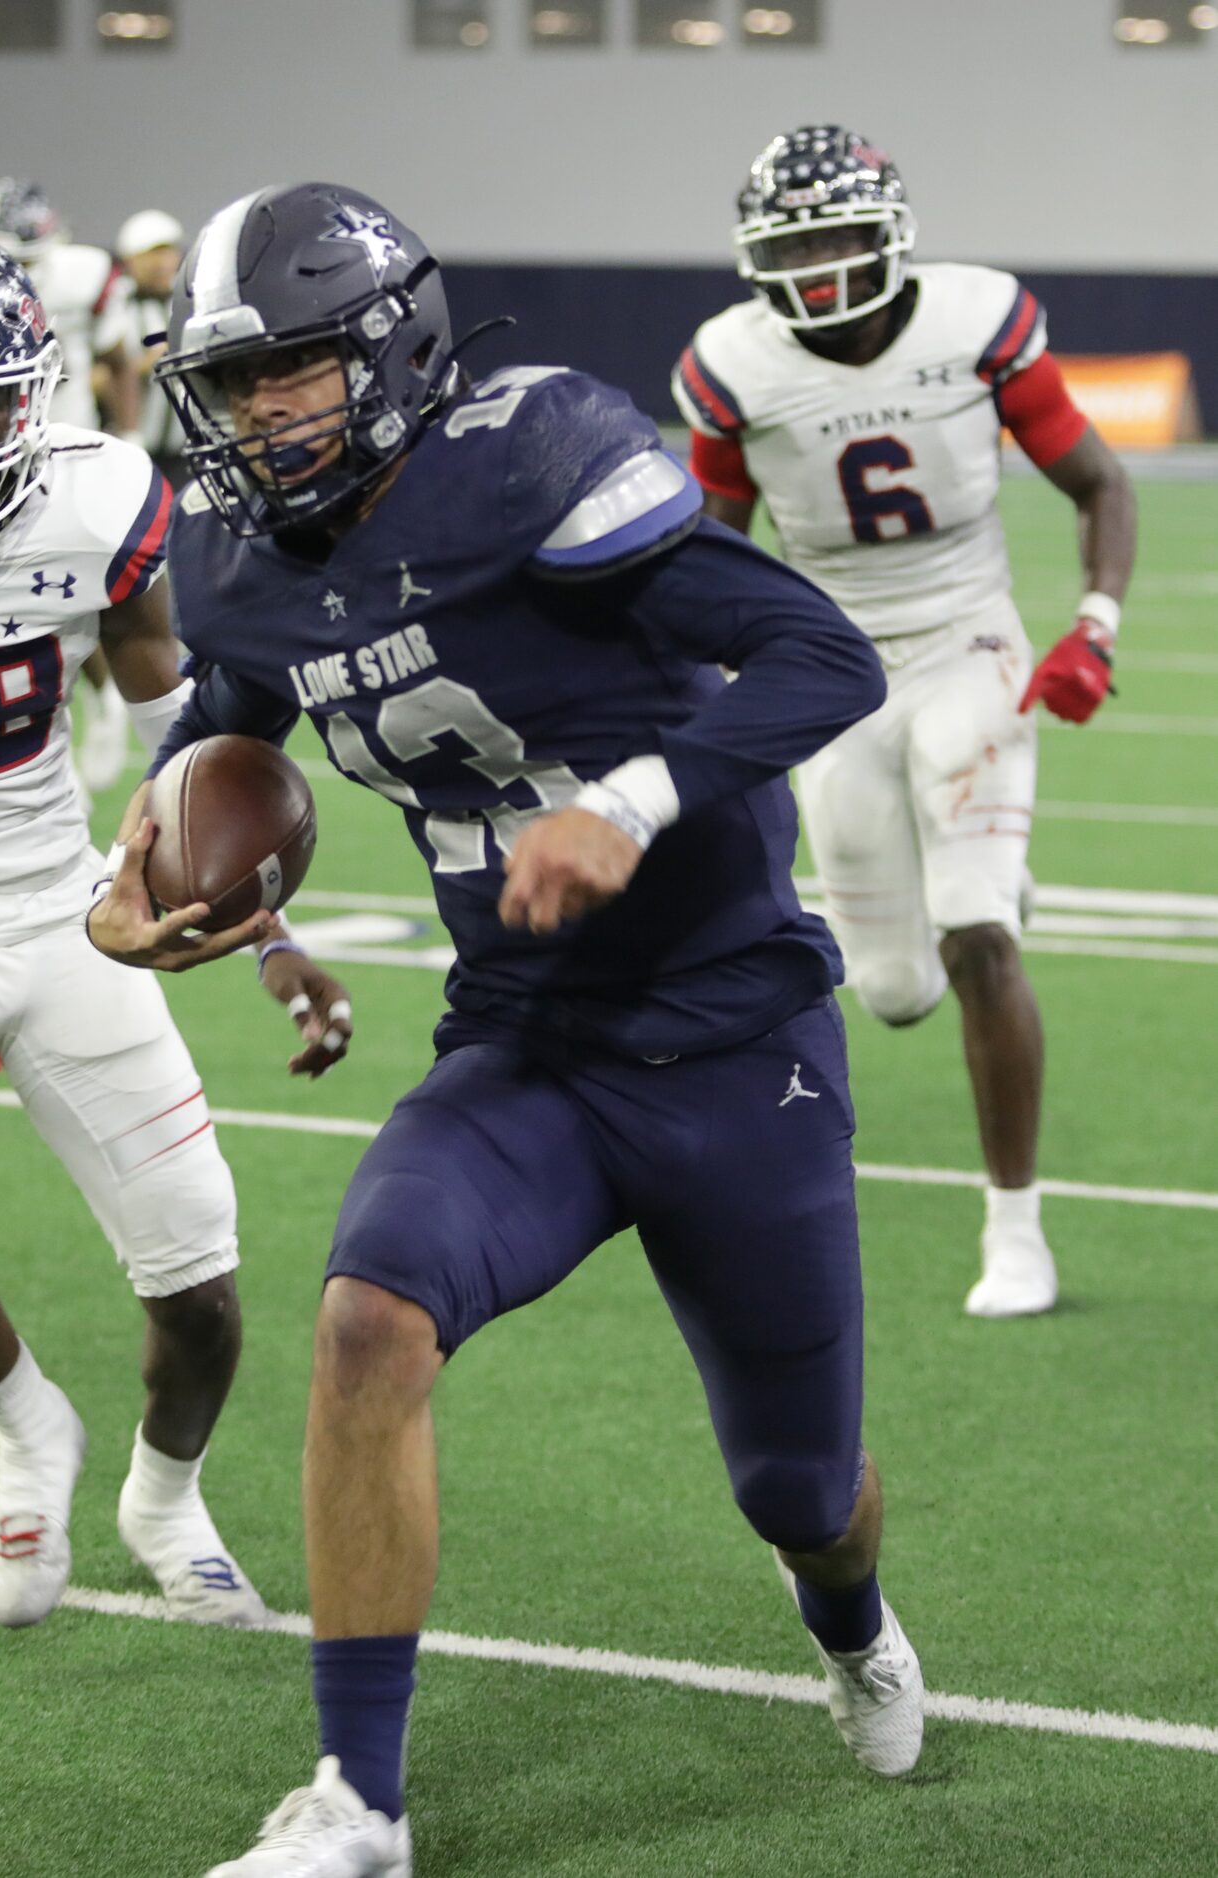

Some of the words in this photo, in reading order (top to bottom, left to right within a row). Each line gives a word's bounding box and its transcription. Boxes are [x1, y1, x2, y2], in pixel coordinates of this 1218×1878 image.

[835, 409, 896, 433] RYAN
[837, 434, 935, 543] 6
[288, 652, 358, 709] LONE
[355, 623, 439, 690] STAR
